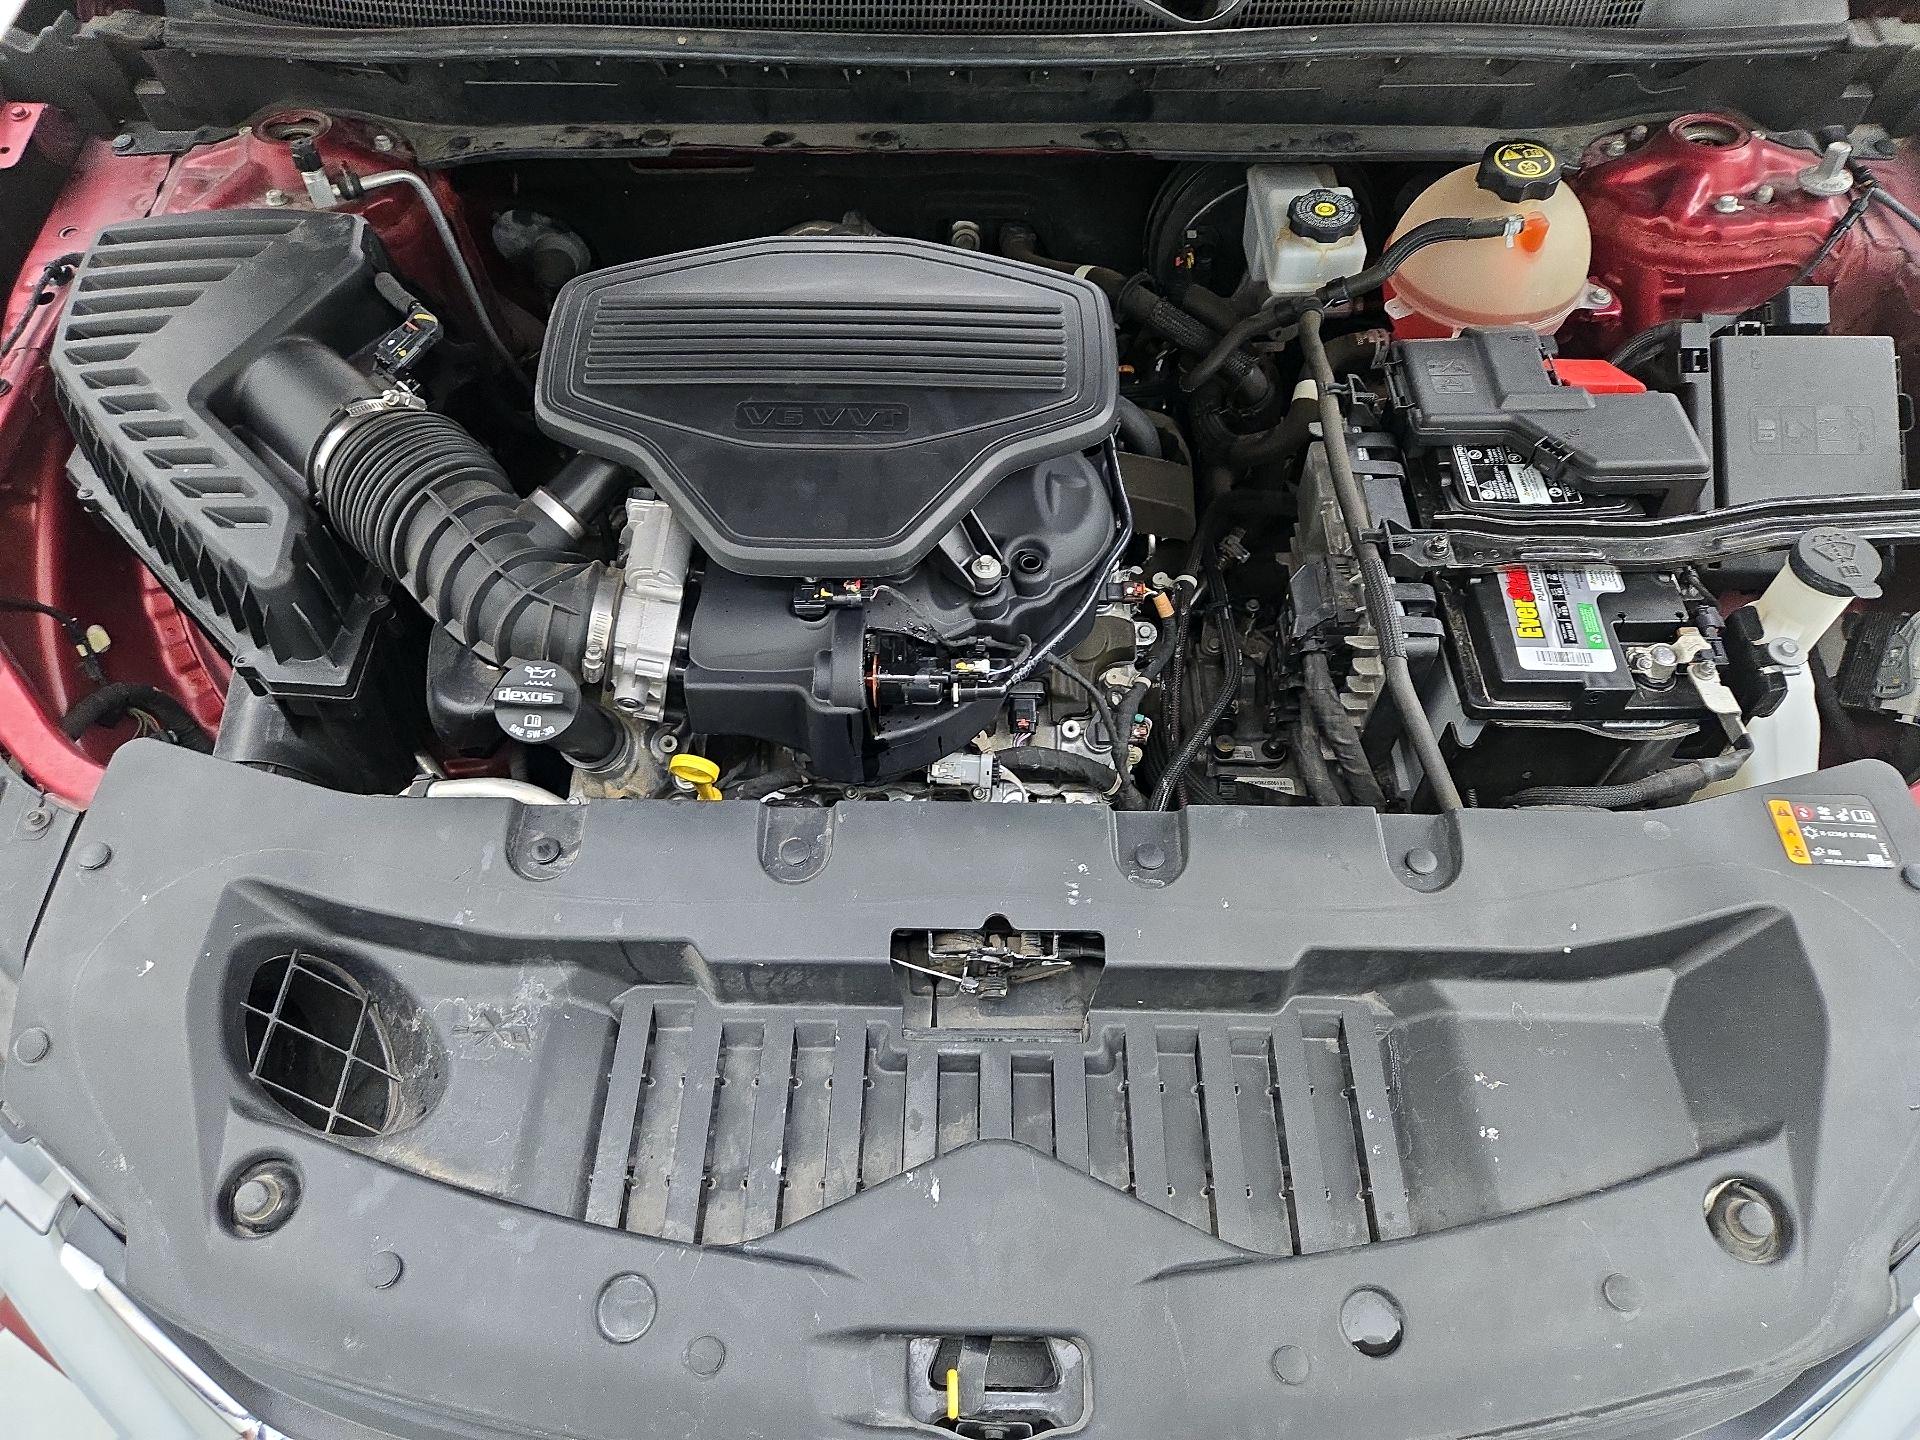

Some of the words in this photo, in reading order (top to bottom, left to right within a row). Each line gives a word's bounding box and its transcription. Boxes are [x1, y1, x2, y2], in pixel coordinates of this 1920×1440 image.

[743, 407, 804, 426] V6
[813, 407, 903, 427] VVT
[1529, 570, 1547, 602] PLATINU
[498, 688, 556, 702] dexos
[509, 723, 525, 736] SAE
[527, 725, 555, 738] 5W-30
